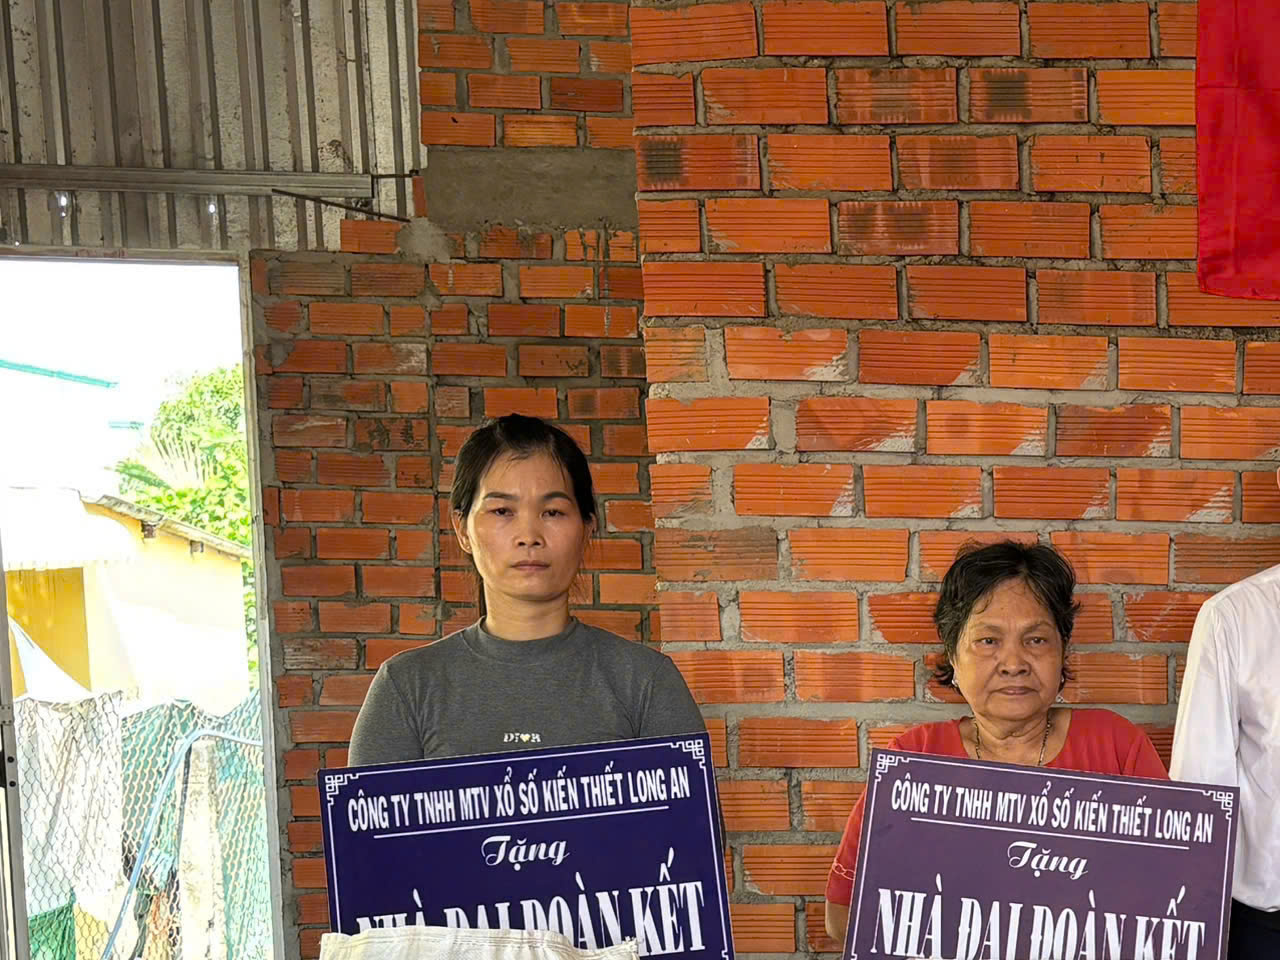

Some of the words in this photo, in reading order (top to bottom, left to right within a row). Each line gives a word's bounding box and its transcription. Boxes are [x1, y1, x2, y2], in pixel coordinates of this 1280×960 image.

[348, 790, 388, 831] CÔNG
[390, 795, 409, 826] TY
[414, 789, 456, 825] TNHH
[459, 787, 489, 821] MTV
[494, 767, 516, 817] XỔ
[519, 768, 539, 813] SỐ
[543, 766, 578, 811] KIẾN
[580, 761, 624, 809] THIẾT
[631, 769, 667, 801] LONG
[670, 766, 690, 798] AN
[891, 773, 930, 814] CÔNG
[934, 785, 952, 816] TY
[955, 786, 992, 820] TNHH
[995, 791, 1026, 823] MTV
[1028, 781, 1049, 827] XỔ
[1051, 788, 1072, 829] SỐ
[1074, 791, 1106, 832] KIẾN
[1112, 796, 1152, 838] THIẾT
[1156, 812, 1191, 840] LONG
[1193, 814, 1213, 843] AN
[481, 835, 570, 871] Tặng
[1008, 841, 1088, 880] Tặng
[628, 847, 705, 956] KẾT
[871, 874, 943, 959] NHÀ
[1030, 889, 1127, 960] ĐOÀN
